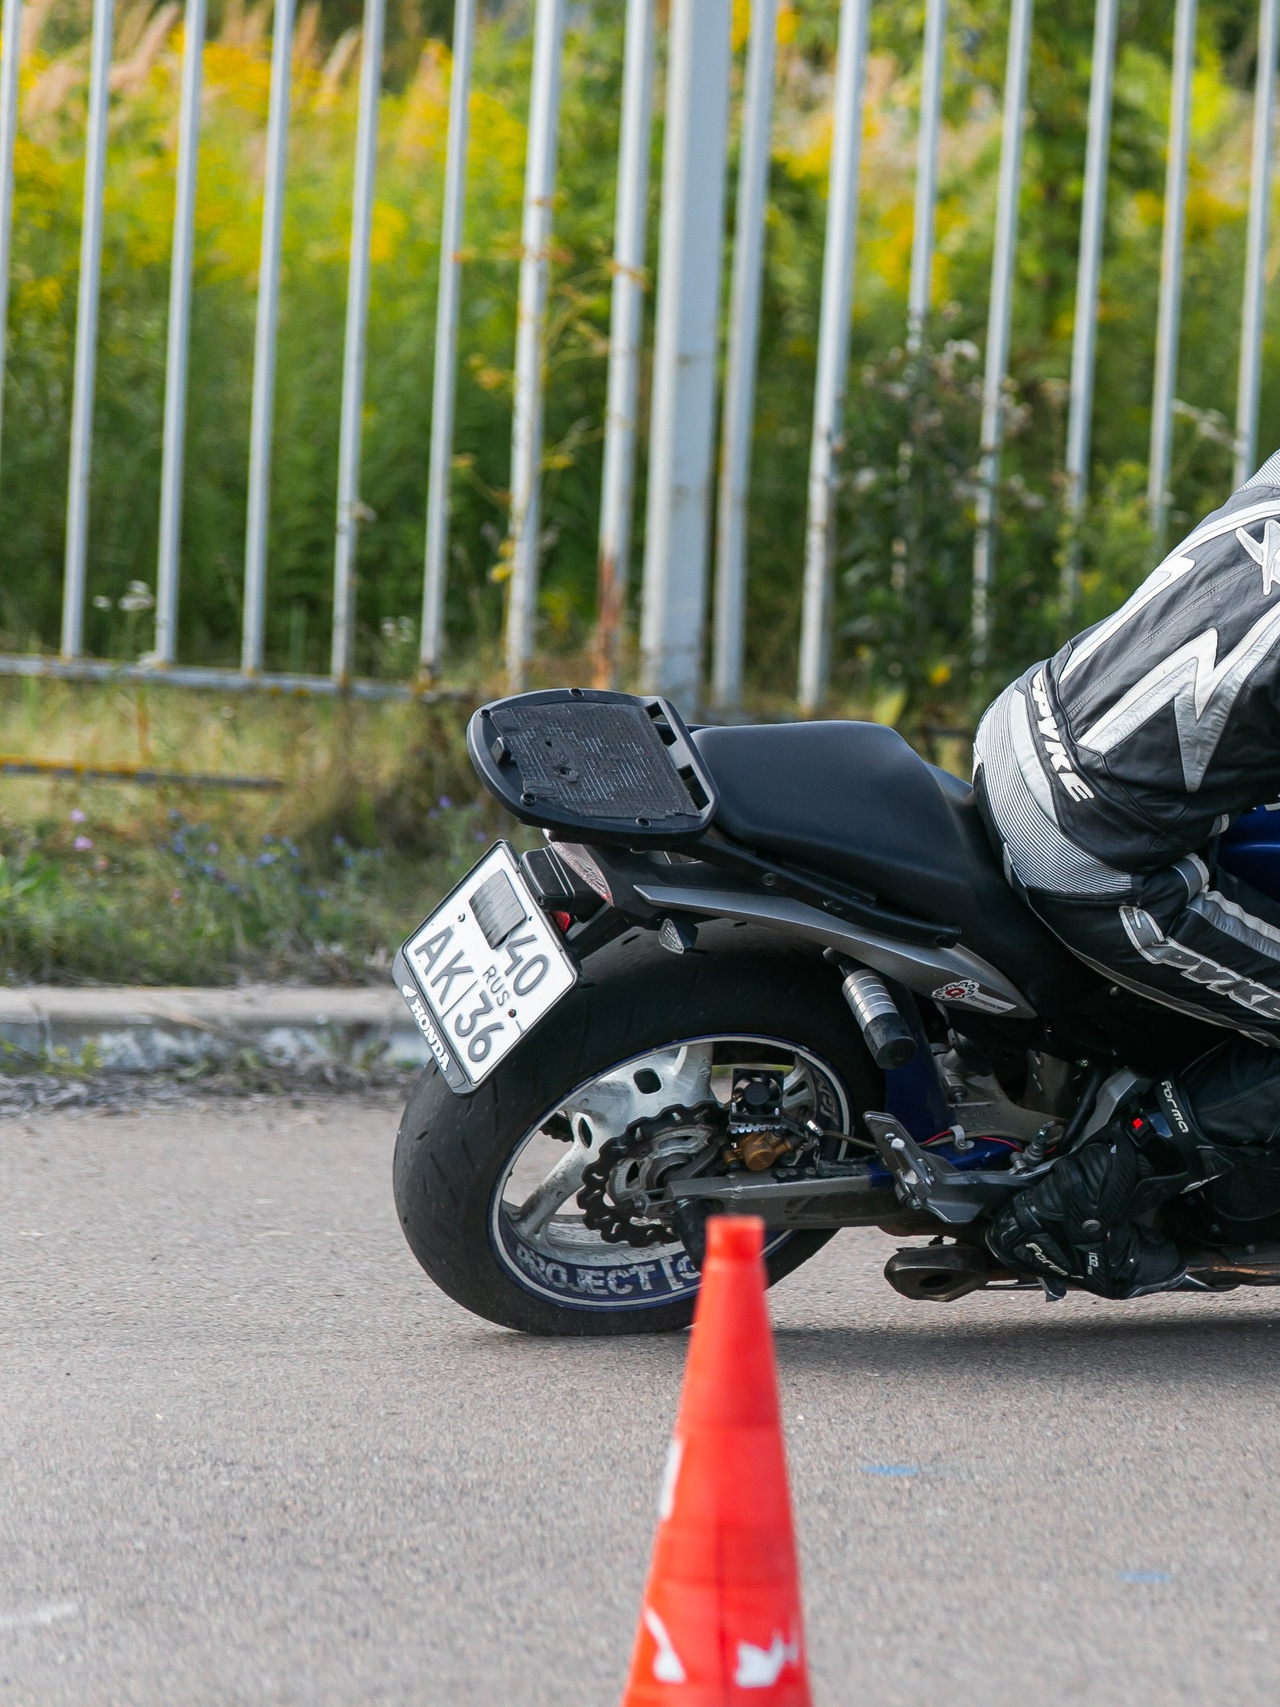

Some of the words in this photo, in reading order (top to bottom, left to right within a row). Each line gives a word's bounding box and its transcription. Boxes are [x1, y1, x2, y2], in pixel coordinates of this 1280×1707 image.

[414, 925, 474, 1006] AK
[455, 989, 504, 1062] 36
[482, 964, 510, 1006] RUS
[410, 999, 450, 1072] HONDA
[516, 1242, 655, 1295] PROJECT
